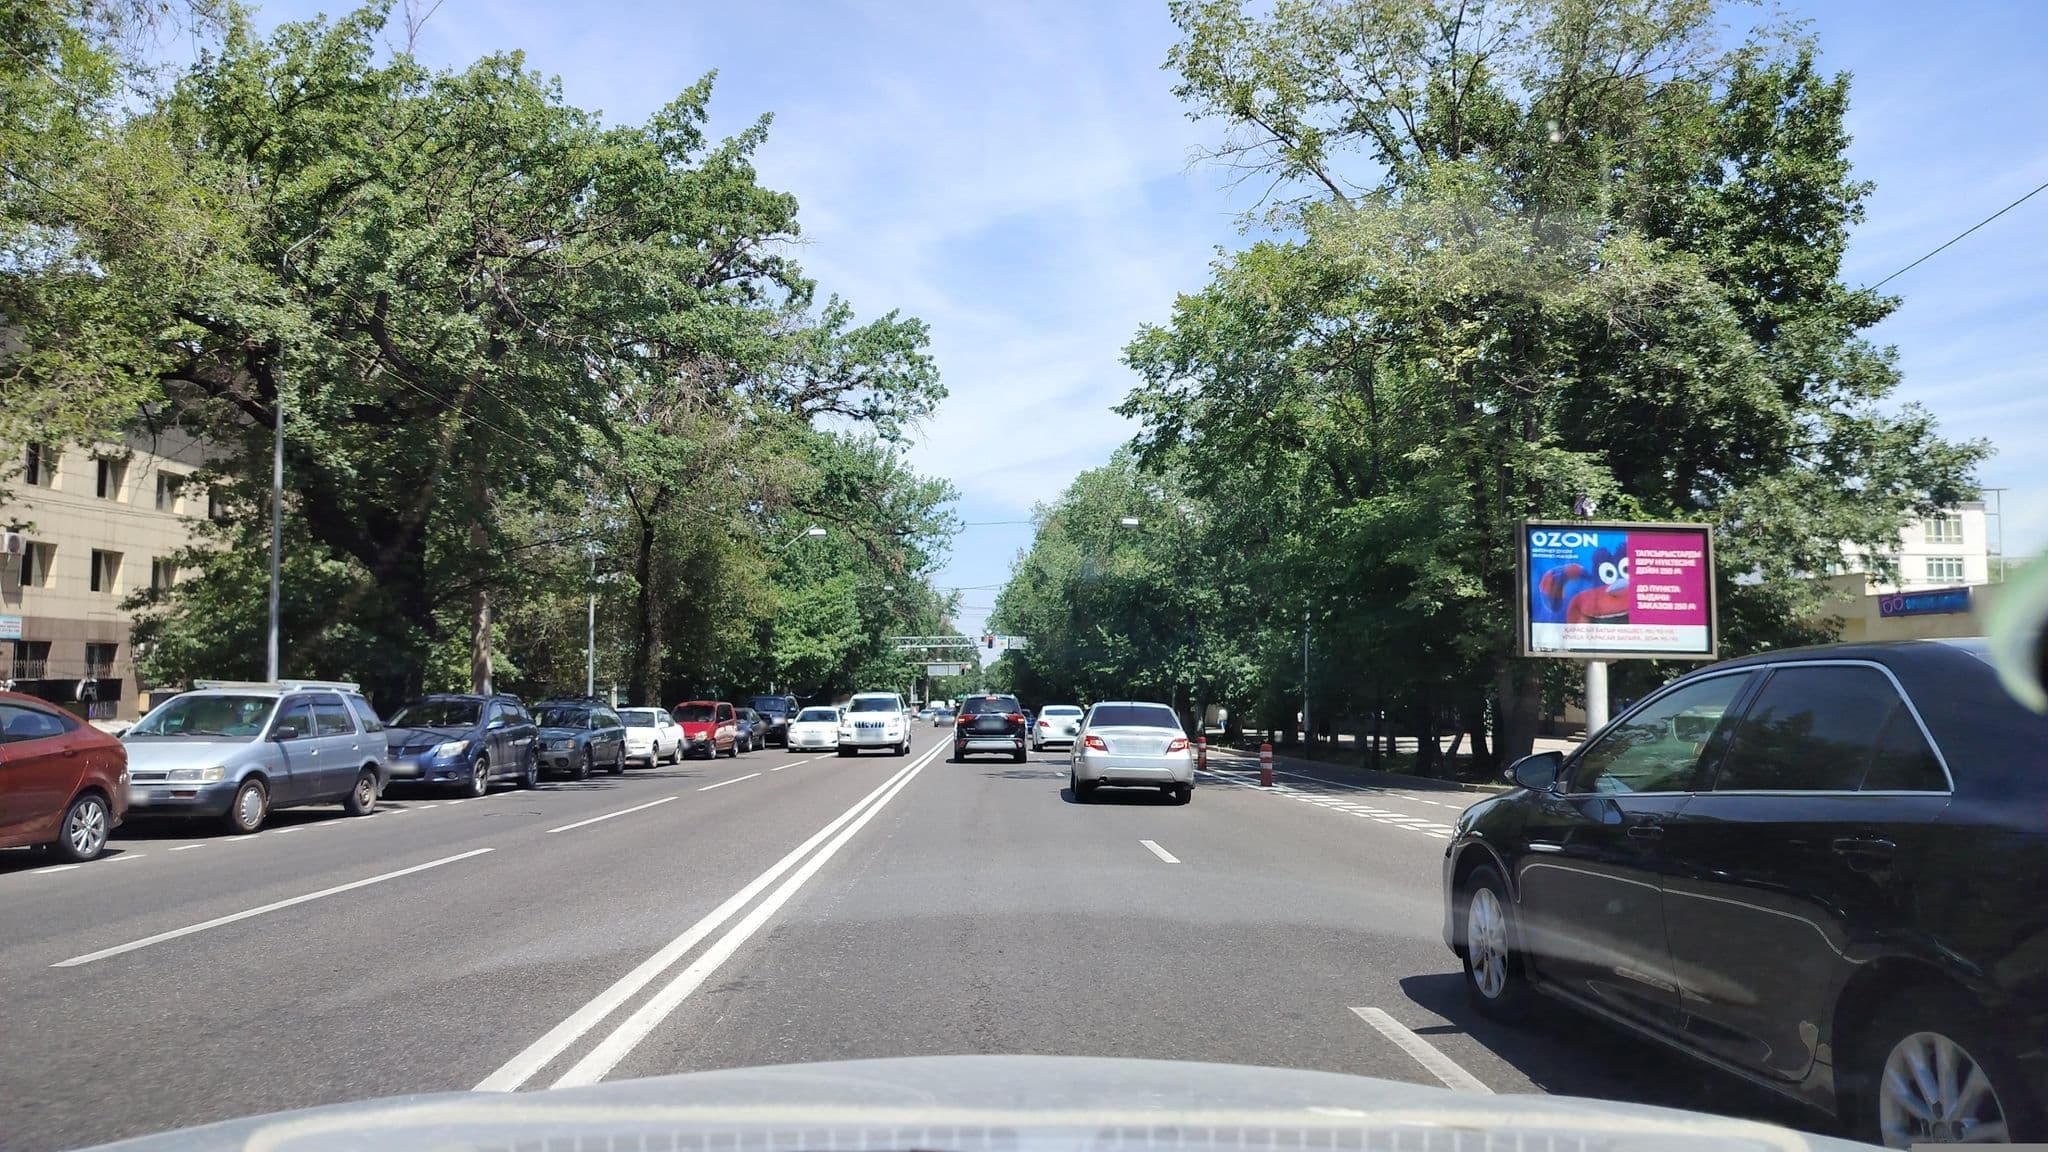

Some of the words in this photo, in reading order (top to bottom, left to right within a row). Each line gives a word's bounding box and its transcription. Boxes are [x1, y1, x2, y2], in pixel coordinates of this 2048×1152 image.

[1531, 532, 1598, 547] OZON
[1636, 585, 1648, 593] ДО
[1649, 585, 1681, 593] ПУНКТА
[1637, 602, 1673, 610] ЗАКАЗОВ
